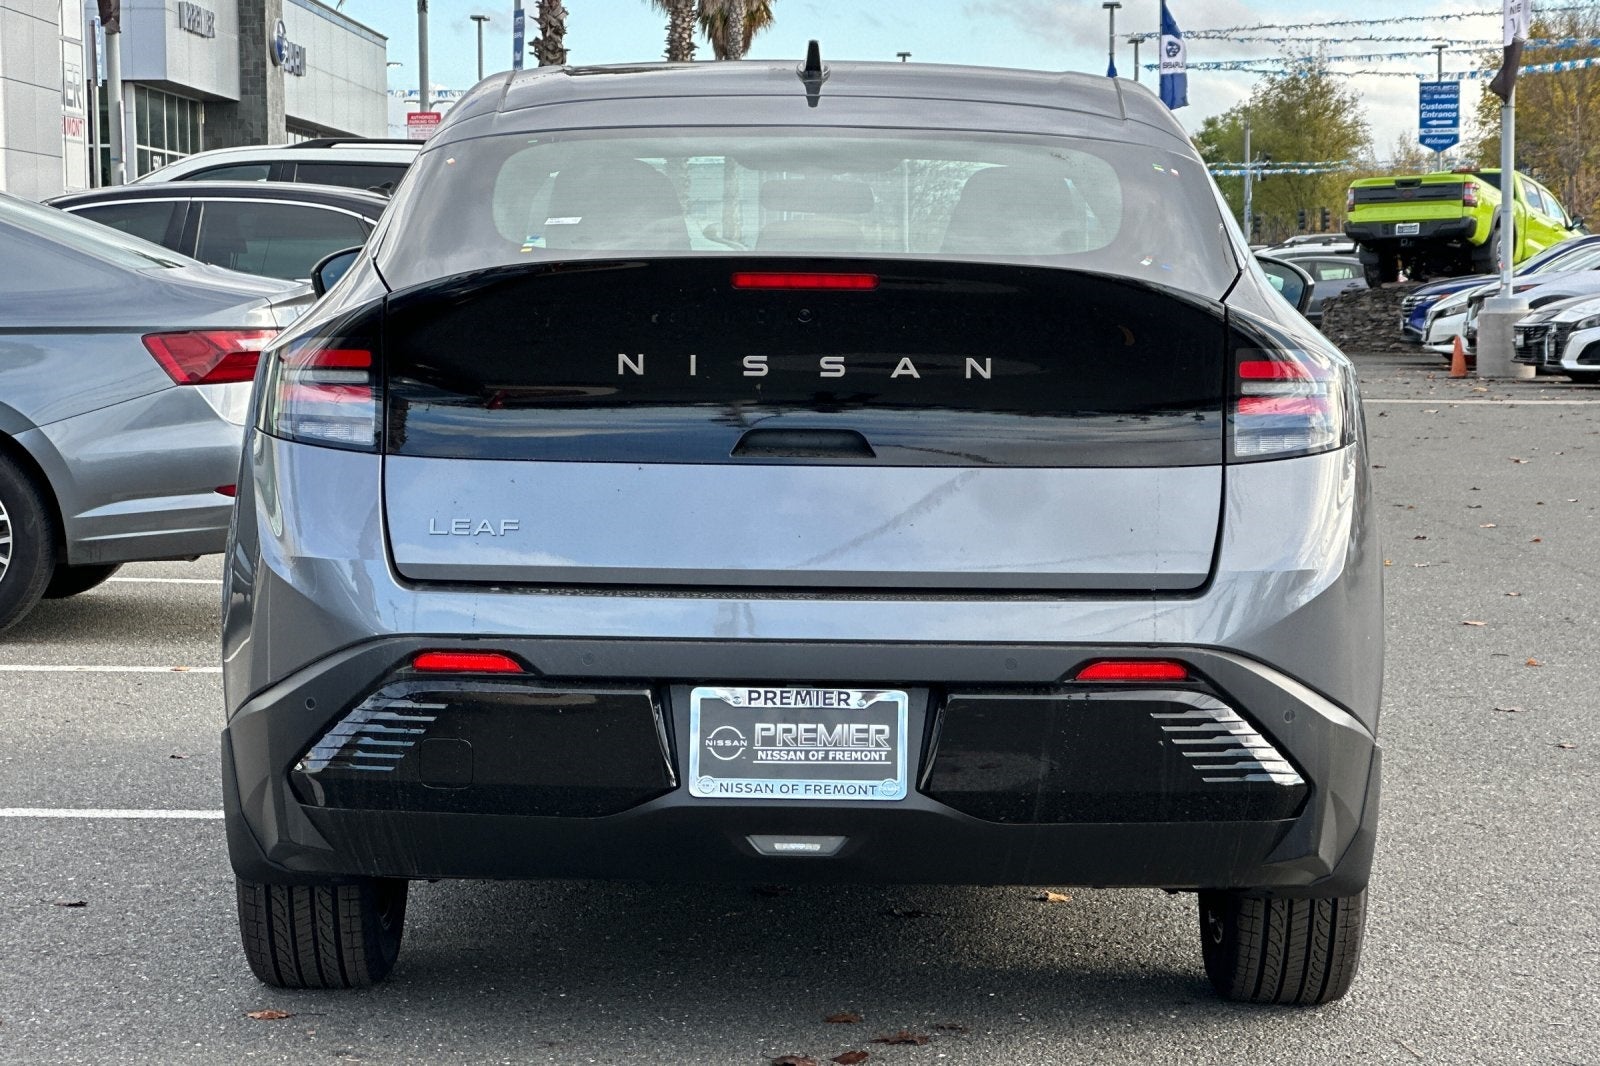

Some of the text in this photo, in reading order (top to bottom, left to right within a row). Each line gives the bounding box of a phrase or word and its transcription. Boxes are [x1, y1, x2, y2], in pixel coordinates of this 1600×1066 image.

[617, 353, 992, 379] NISSAN
[429, 518, 520, 537] LEAF
[747, 689, 851, 707] PREMIER
[705, 739, 748, 747] NISSAN
[754, 722, 890, 748] PREMIER
[757, 751, 888, 761] NISSAN OF FREMONT
[719, 782, 878, 795] NISSAN OF FREMONT
